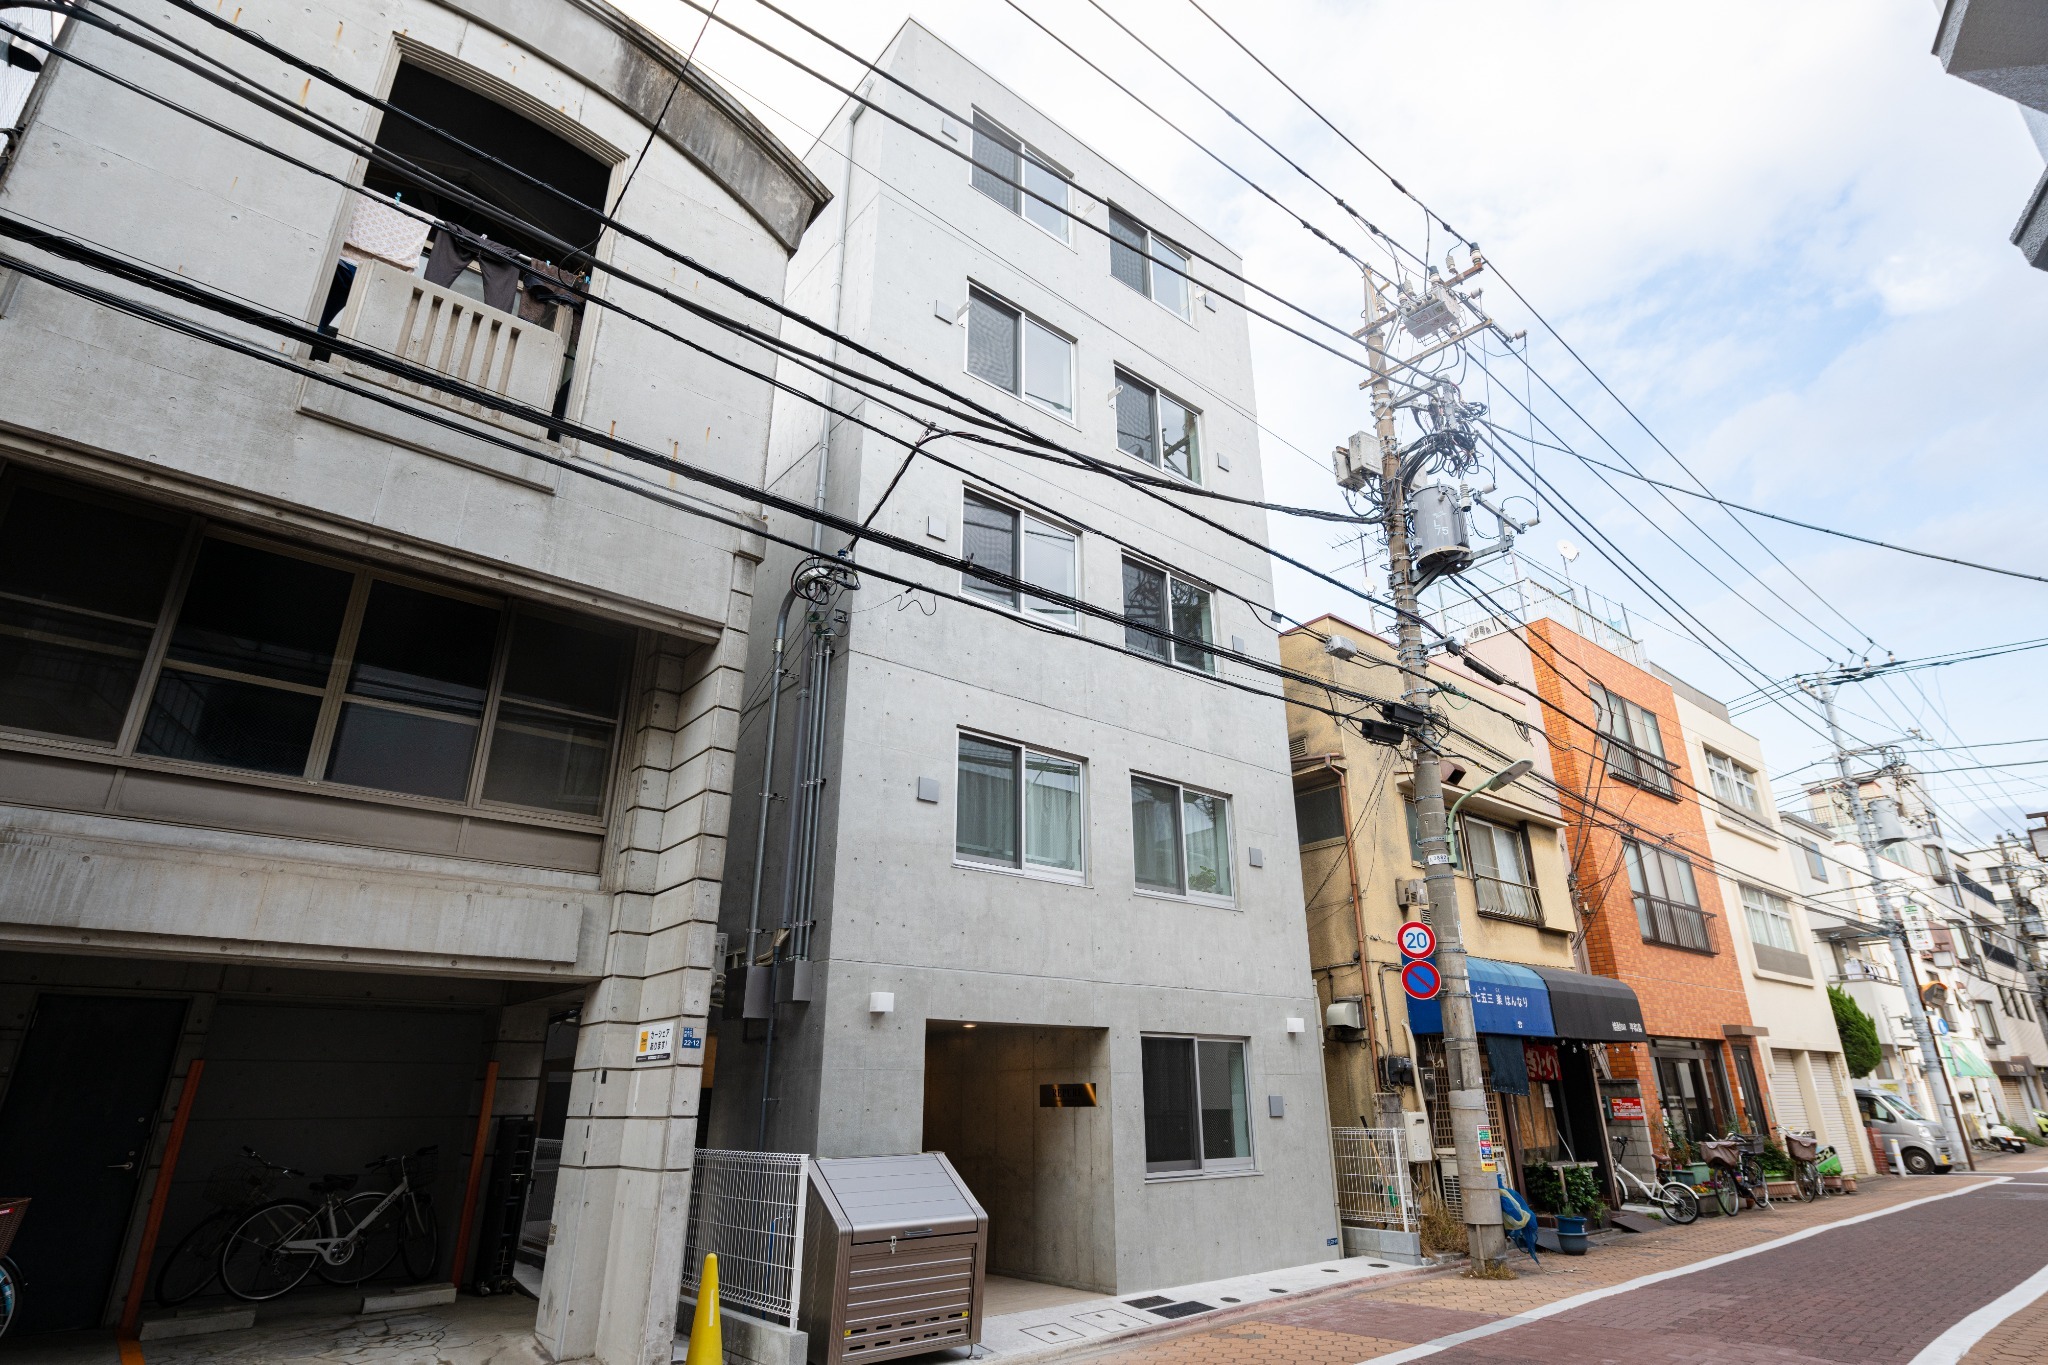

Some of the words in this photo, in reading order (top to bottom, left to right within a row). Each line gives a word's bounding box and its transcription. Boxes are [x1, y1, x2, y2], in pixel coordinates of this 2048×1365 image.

[1434, 527, 1449, 536] 75
[1405, 932, 1427, 949] 20
[1504, 995, 1528, 1008] はんなり
[650, 1028, 670, 1039] カーシェア
[683, 1039, 700, 1047] 22-12
[375, 1193, 397, 1213] Vincent
